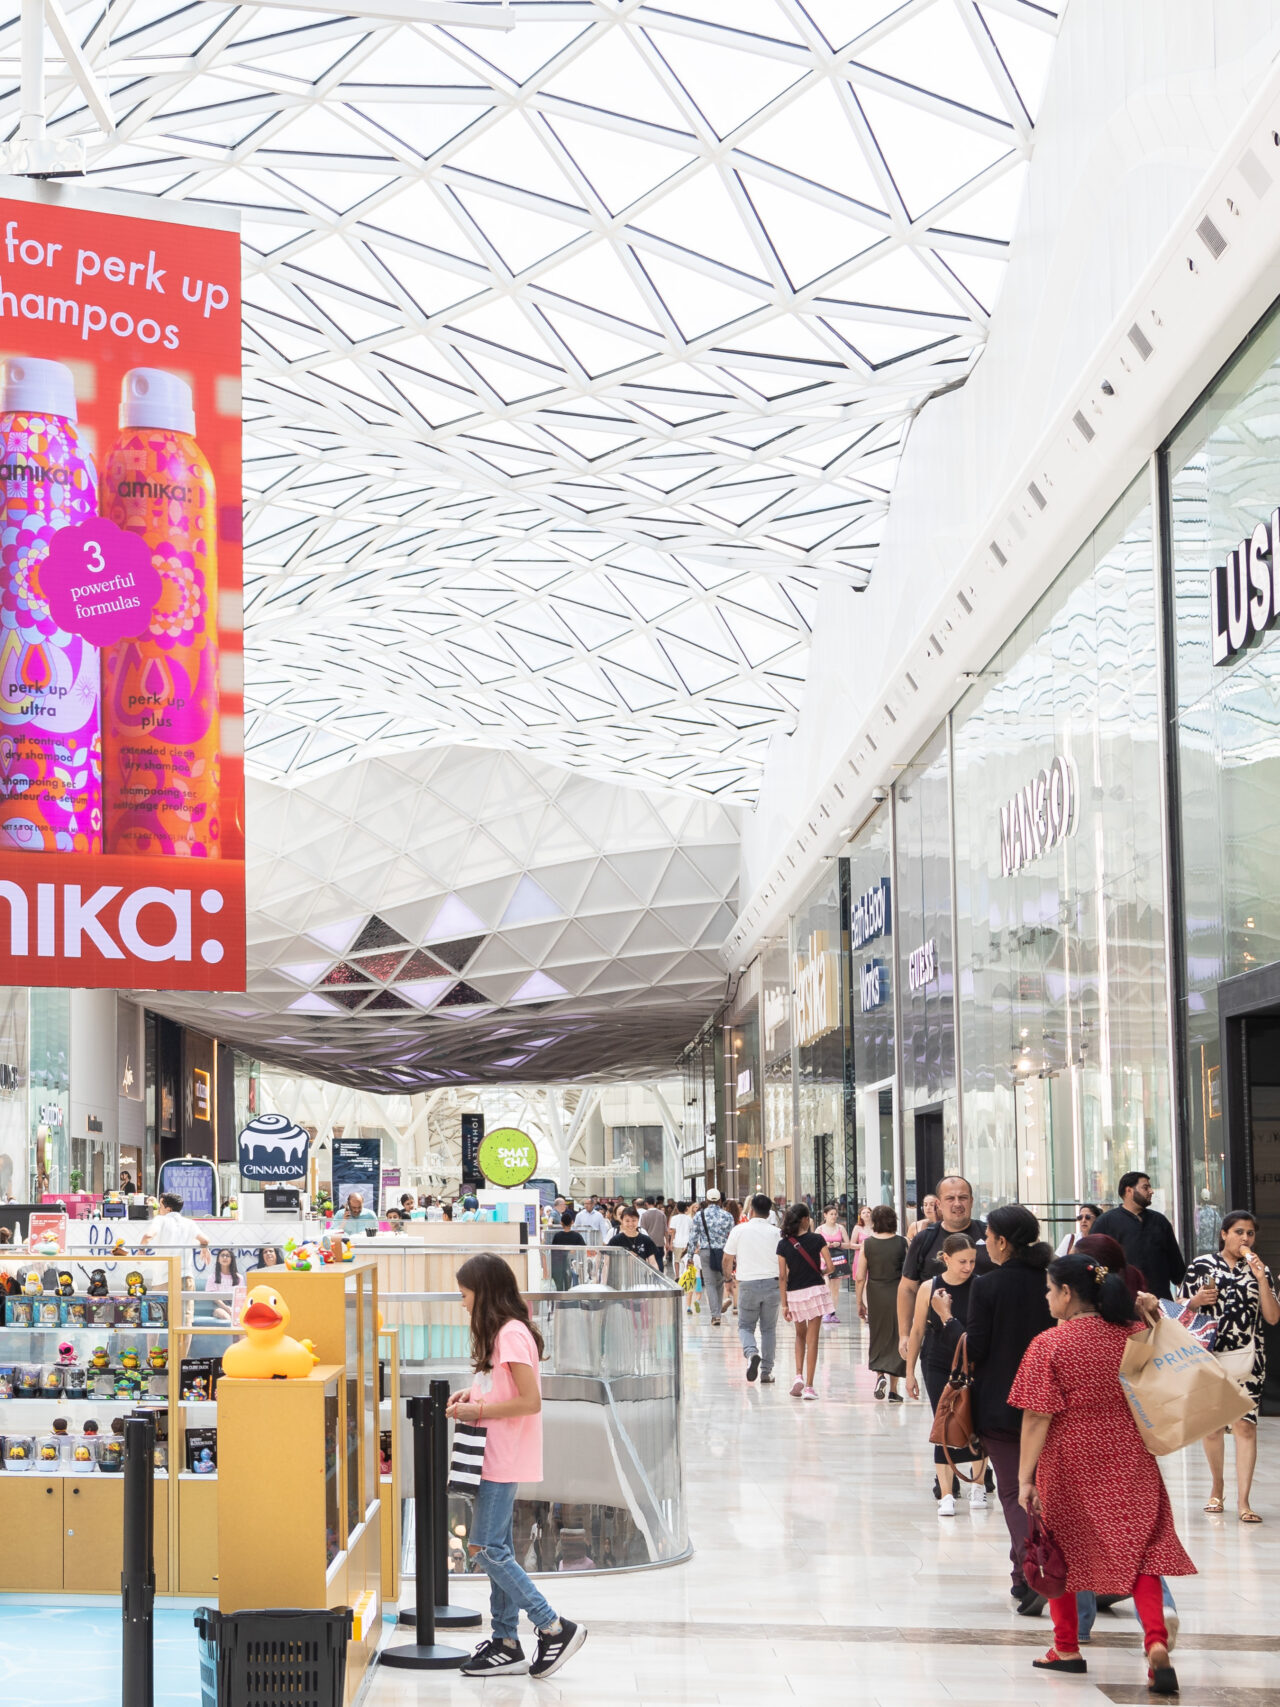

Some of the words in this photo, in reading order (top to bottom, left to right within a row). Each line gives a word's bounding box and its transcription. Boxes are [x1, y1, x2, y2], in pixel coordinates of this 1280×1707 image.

[5, 221, 63, 267] for
[75, 251, 167, 294] perk
[182, 276, 229, 318] up
[82, 540, 106, 573] 3
[70, 572, 136, 602] powerful
[1210, 507, 1280, 667] LUS
[75, 593, 141, 620] formulas
[9, 681, 44, 697] perk
[49, 685, 67, 699] up
[20, 702, 56, 717] ultra
[128, 692, 161, 708] perk
[168, 698, 185, 711] up
[141, 713, 173, 730] plus
[13, 735, 26, 745] oil
[29, 736, 65, 747] control
[5, 750, 22, 762] dry
[25, 750, 73, 763] shampoo
[170, 747, 195, 758] clean
[125, 760, 140, 771] dry
[144, 760, 190, 772] shampoo
[999, 755, 1076, 878] MANGO
[909, 937, 936, 991] GUESS
[859, 960, 880, 1013] Works
[497, 1147, 530, 1159] SMAT
[243, 1164, 303, 1175] CINNABON
[503, 1157, 530, 1168] CHA
[171, 1176, 205, 1187] WIN
